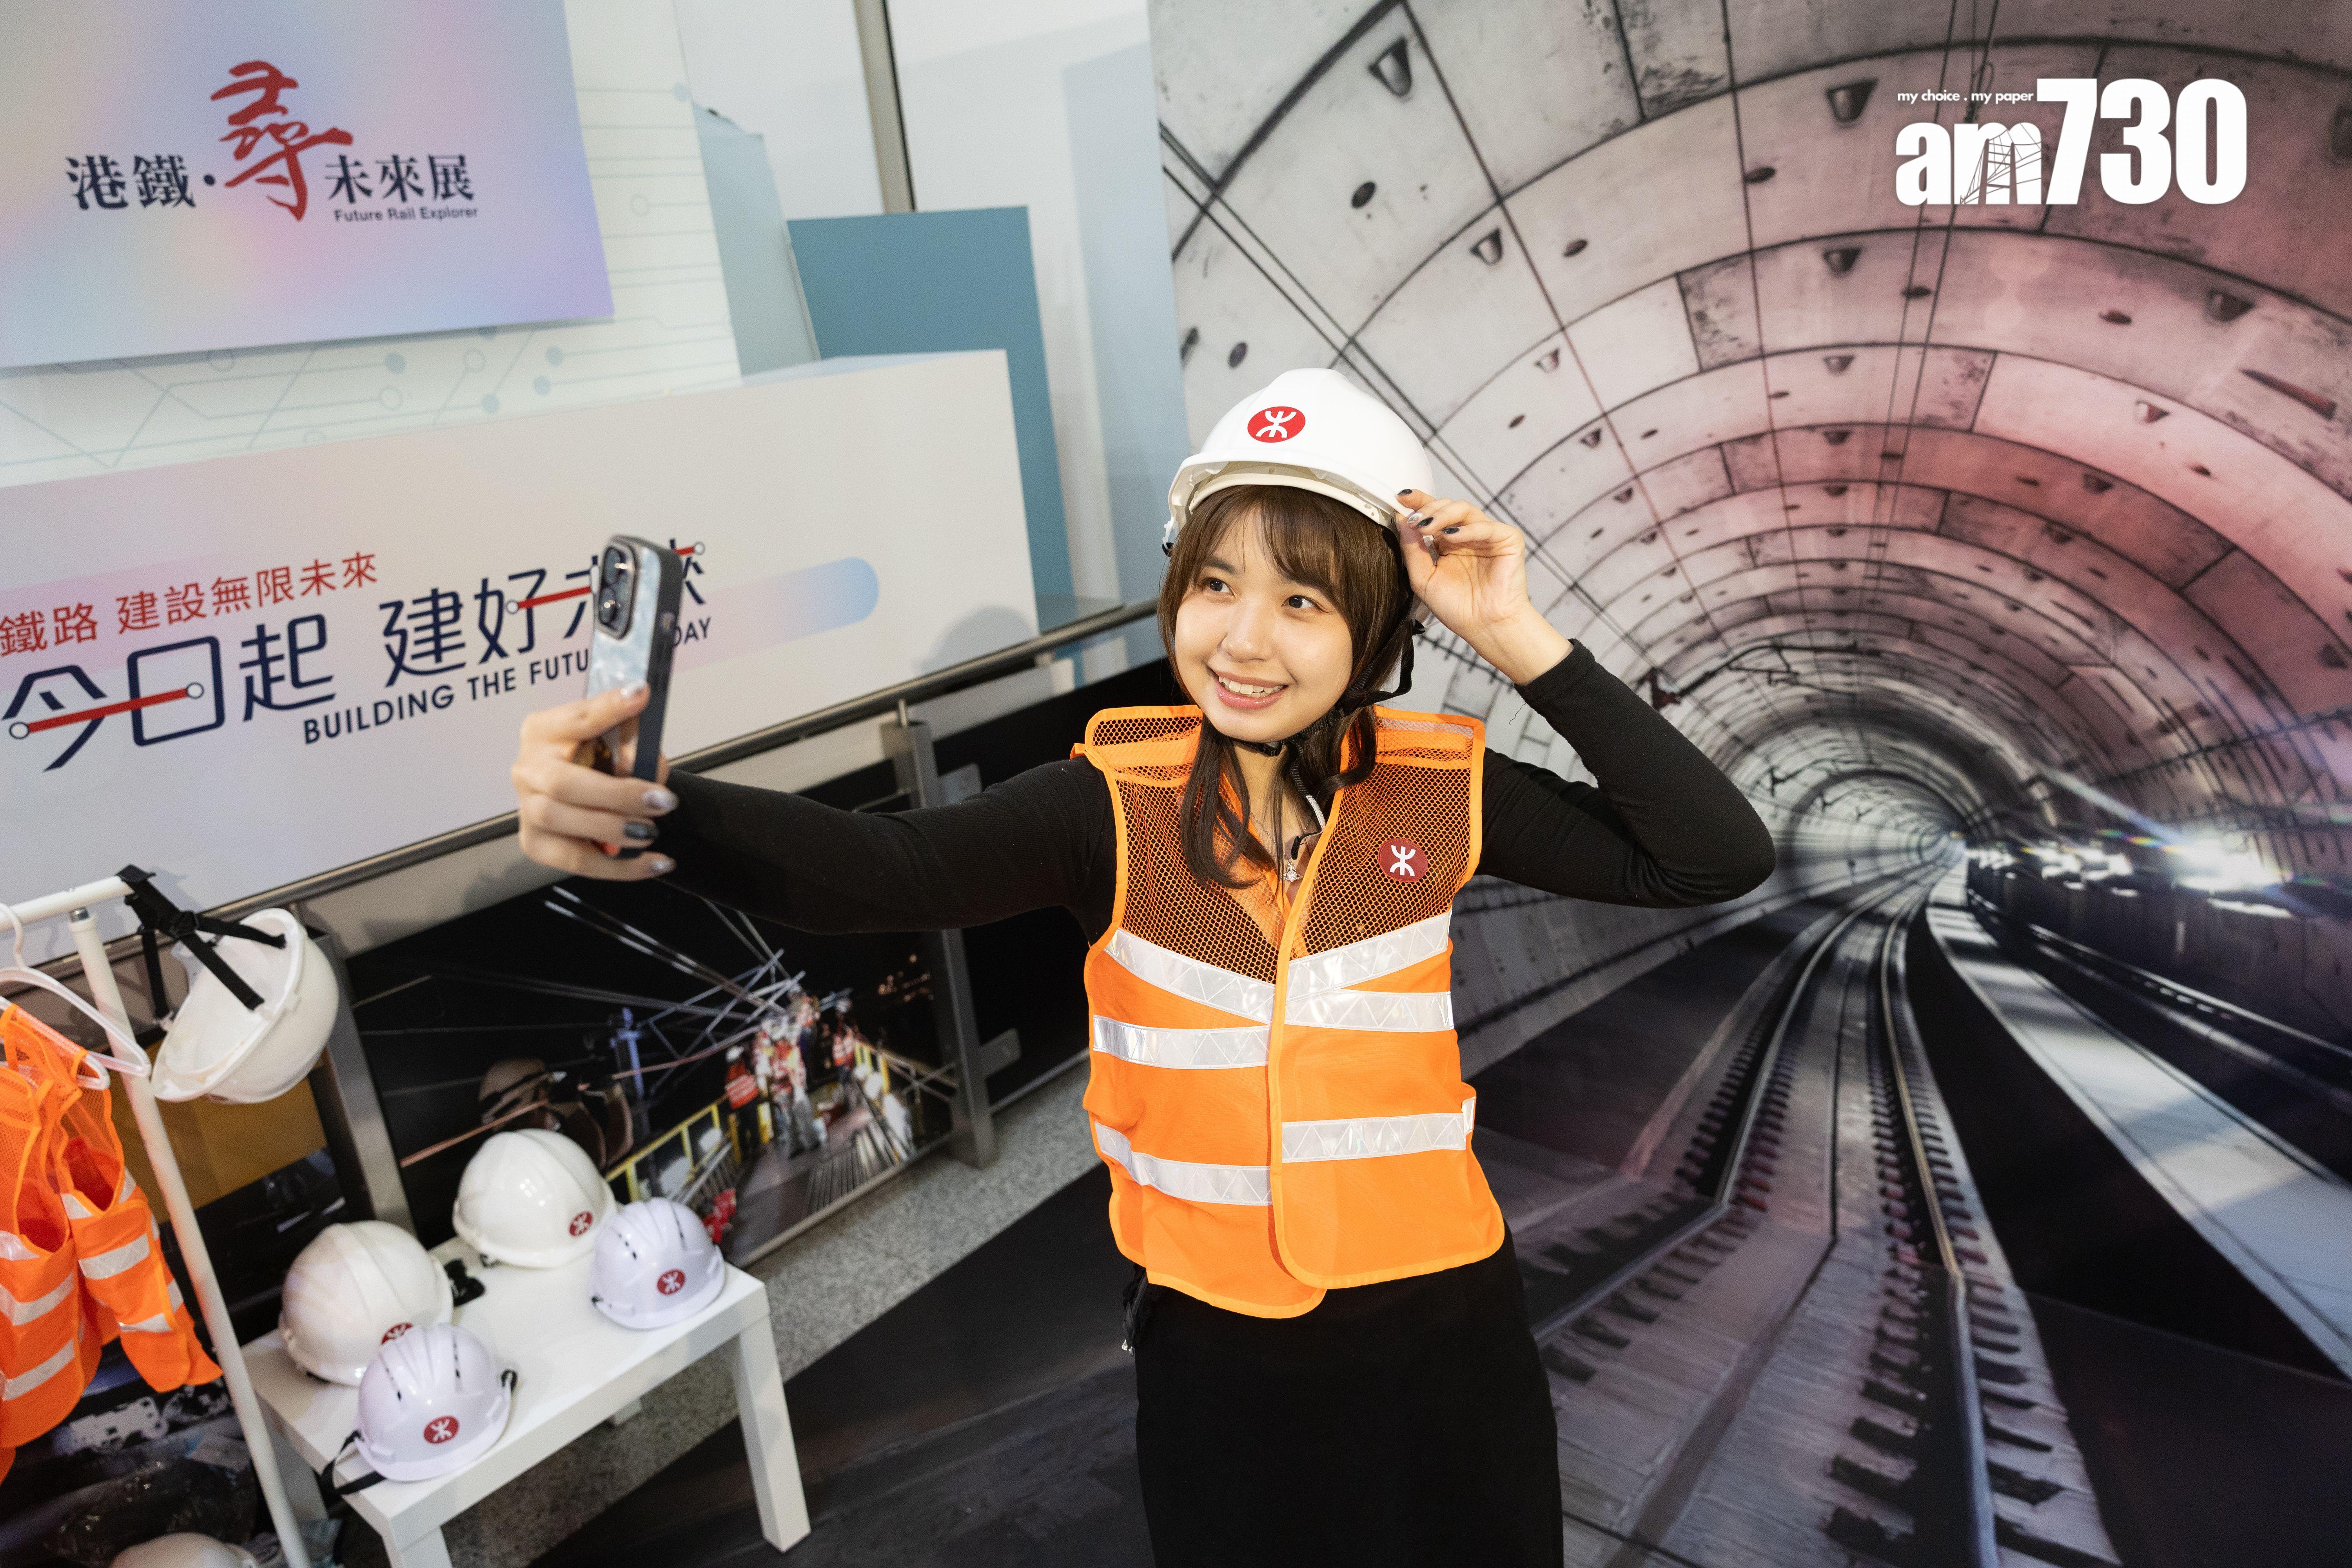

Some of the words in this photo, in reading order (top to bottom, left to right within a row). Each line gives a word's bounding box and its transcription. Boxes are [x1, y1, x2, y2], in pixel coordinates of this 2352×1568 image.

[334, 208, 383, 222] Future
[387, 206, 416, 220] Rail
[419, 205, 478, 221] Explorer
[0, 603, 98, 657] 鐵路
[115, 551, 377, 634] 建設無限未來
[1, 614, 337, 772] 今日起
[303, 684, 455, 744] BUILDING
[468, 667, 517, 701] THE
[530, 648, 589, 685] FUTU
